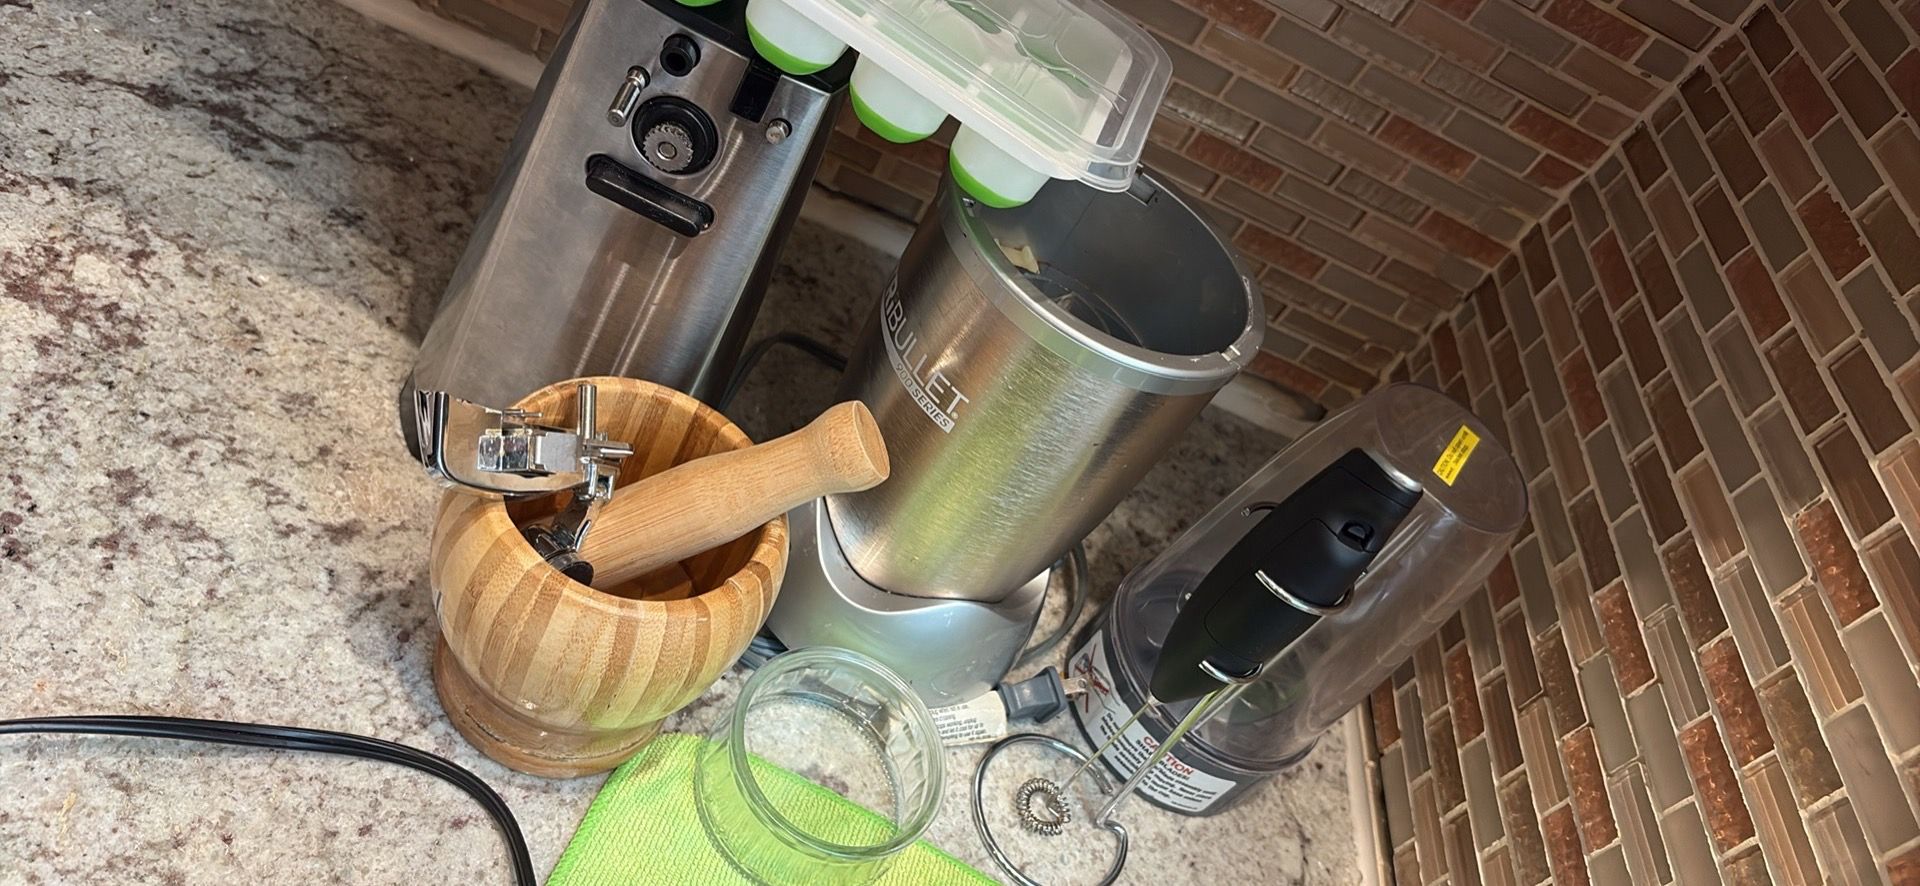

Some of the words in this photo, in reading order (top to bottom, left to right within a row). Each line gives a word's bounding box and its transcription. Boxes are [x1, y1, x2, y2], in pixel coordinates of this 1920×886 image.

[896, 363, 912, 388] 900
[912, 388, 950, 428] SERIES
[1143, 736, 1194, 775] CATION
